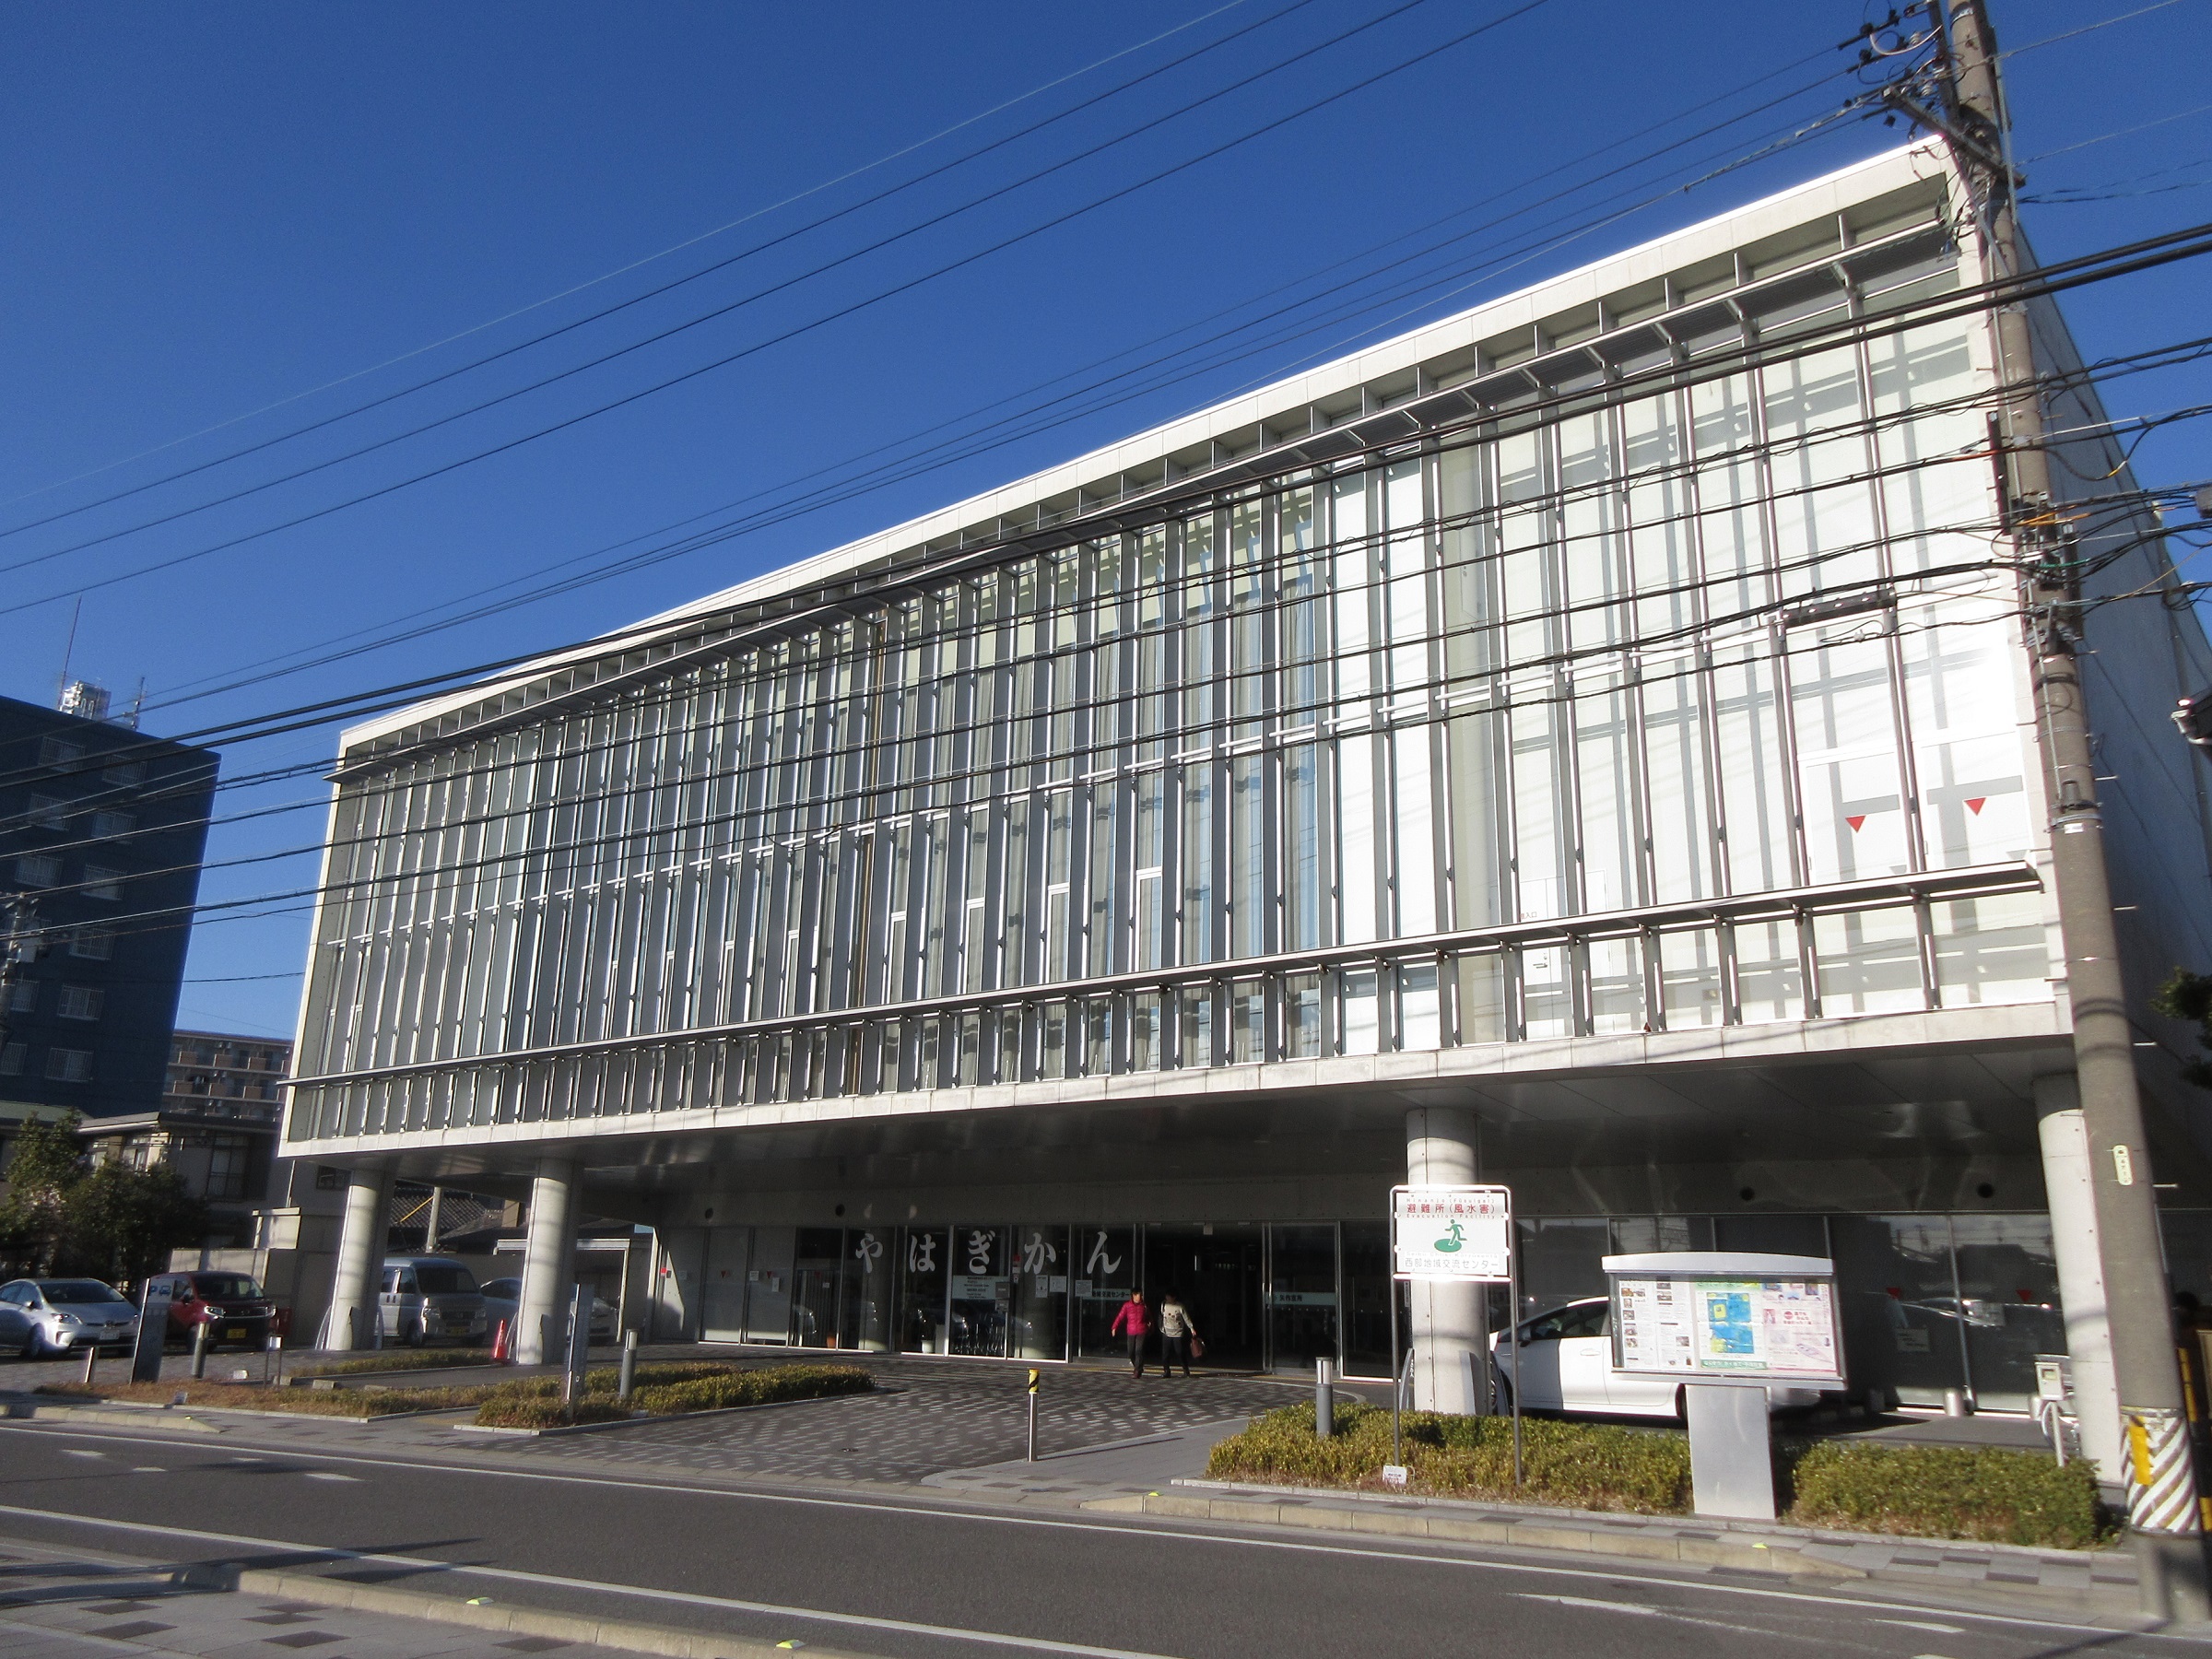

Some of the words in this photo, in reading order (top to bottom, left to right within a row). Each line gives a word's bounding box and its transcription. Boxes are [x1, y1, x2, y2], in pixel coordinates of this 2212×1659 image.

[855, 1230, 1122, 1275] やはぎかん
[1405, 1257, 1499, 1269] 西部地域交流センター
